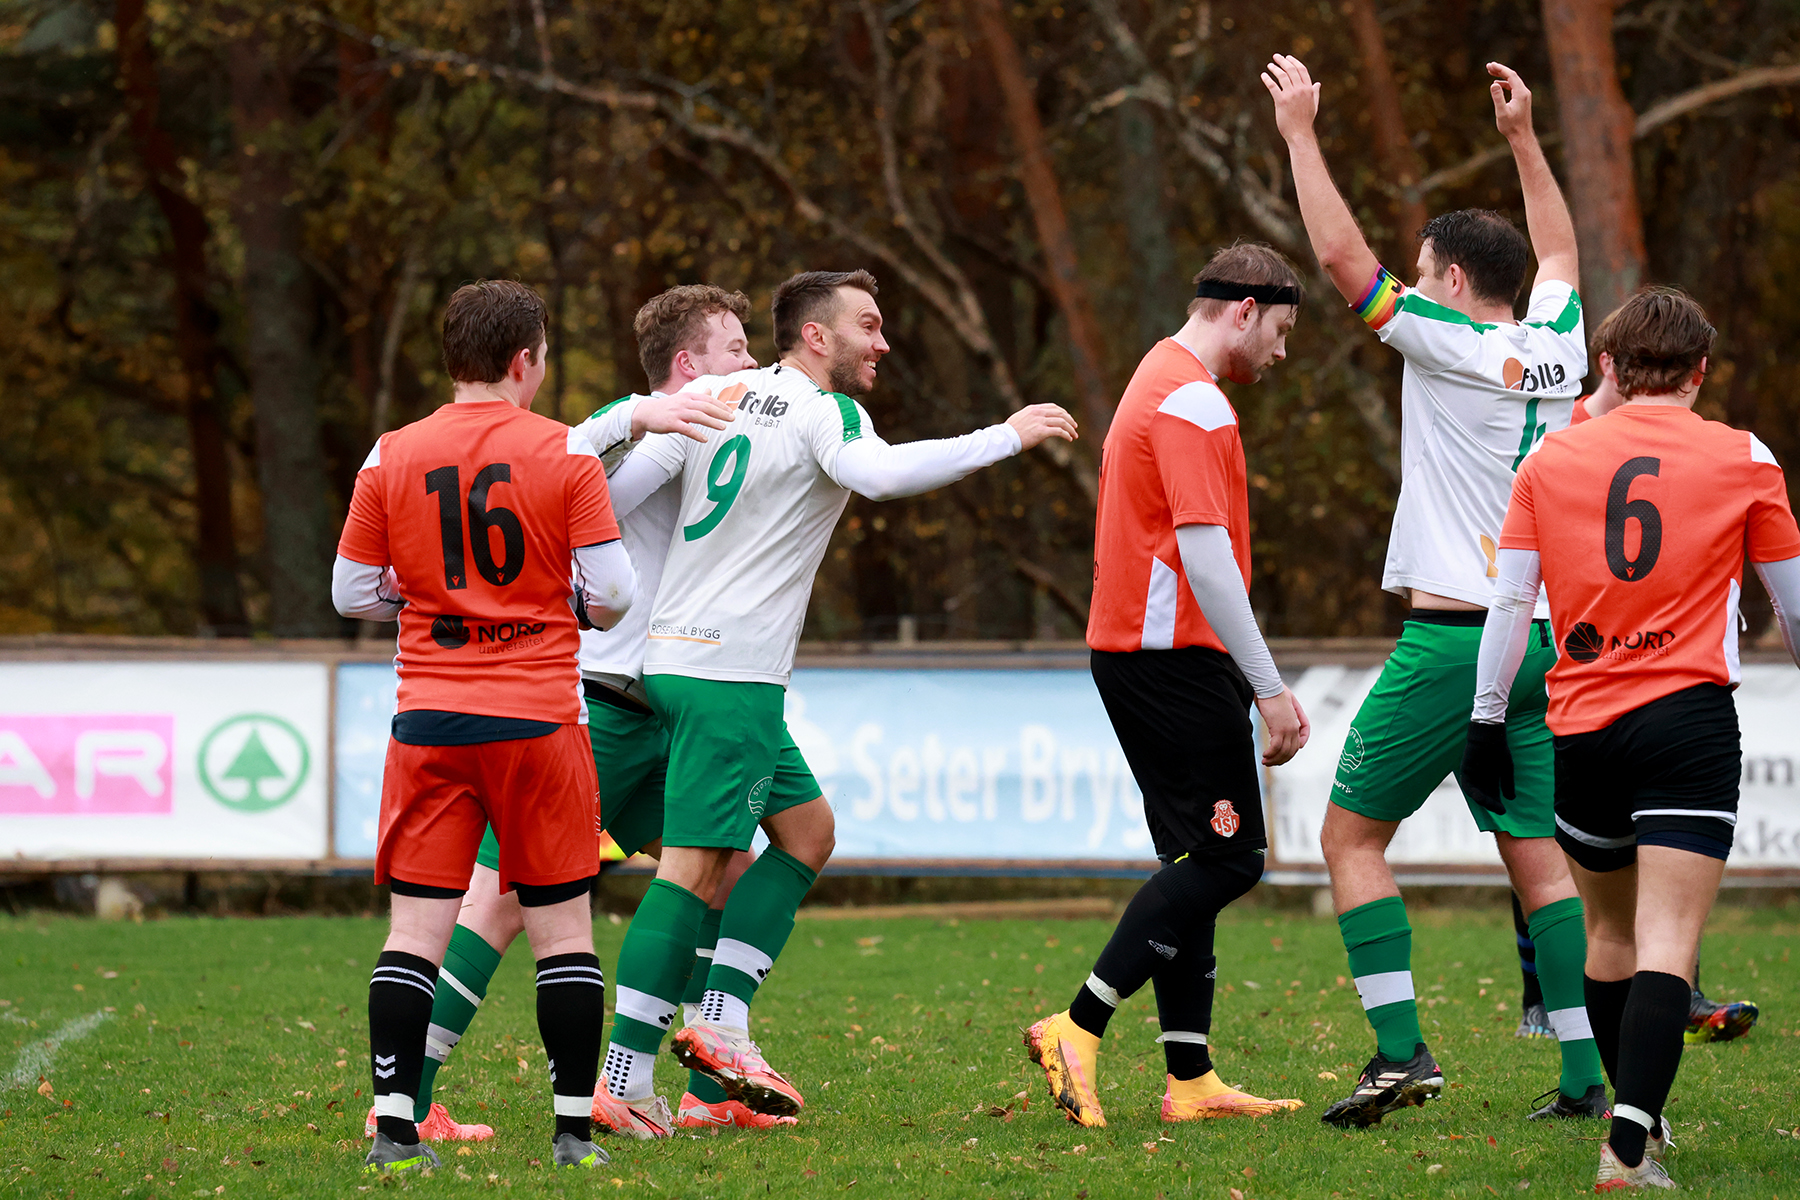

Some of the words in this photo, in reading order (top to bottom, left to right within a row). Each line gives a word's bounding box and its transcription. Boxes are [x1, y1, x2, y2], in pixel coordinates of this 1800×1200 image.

[1520, 363, 1565, 392] folla
[738, 391, 789, 417] folla
[684, 434, 751, 542] 9
[425, 463, 525, 590] 16
[1605, 456, 1662, 582] 6
[478, 623, 547, 642] NORD
[478, 637, 545, 654] universitet
[690, 626, 721, 639] BYGG
[1611, 630, 1675, 651] NORD
[852, 723, 1006, 822] Seter
